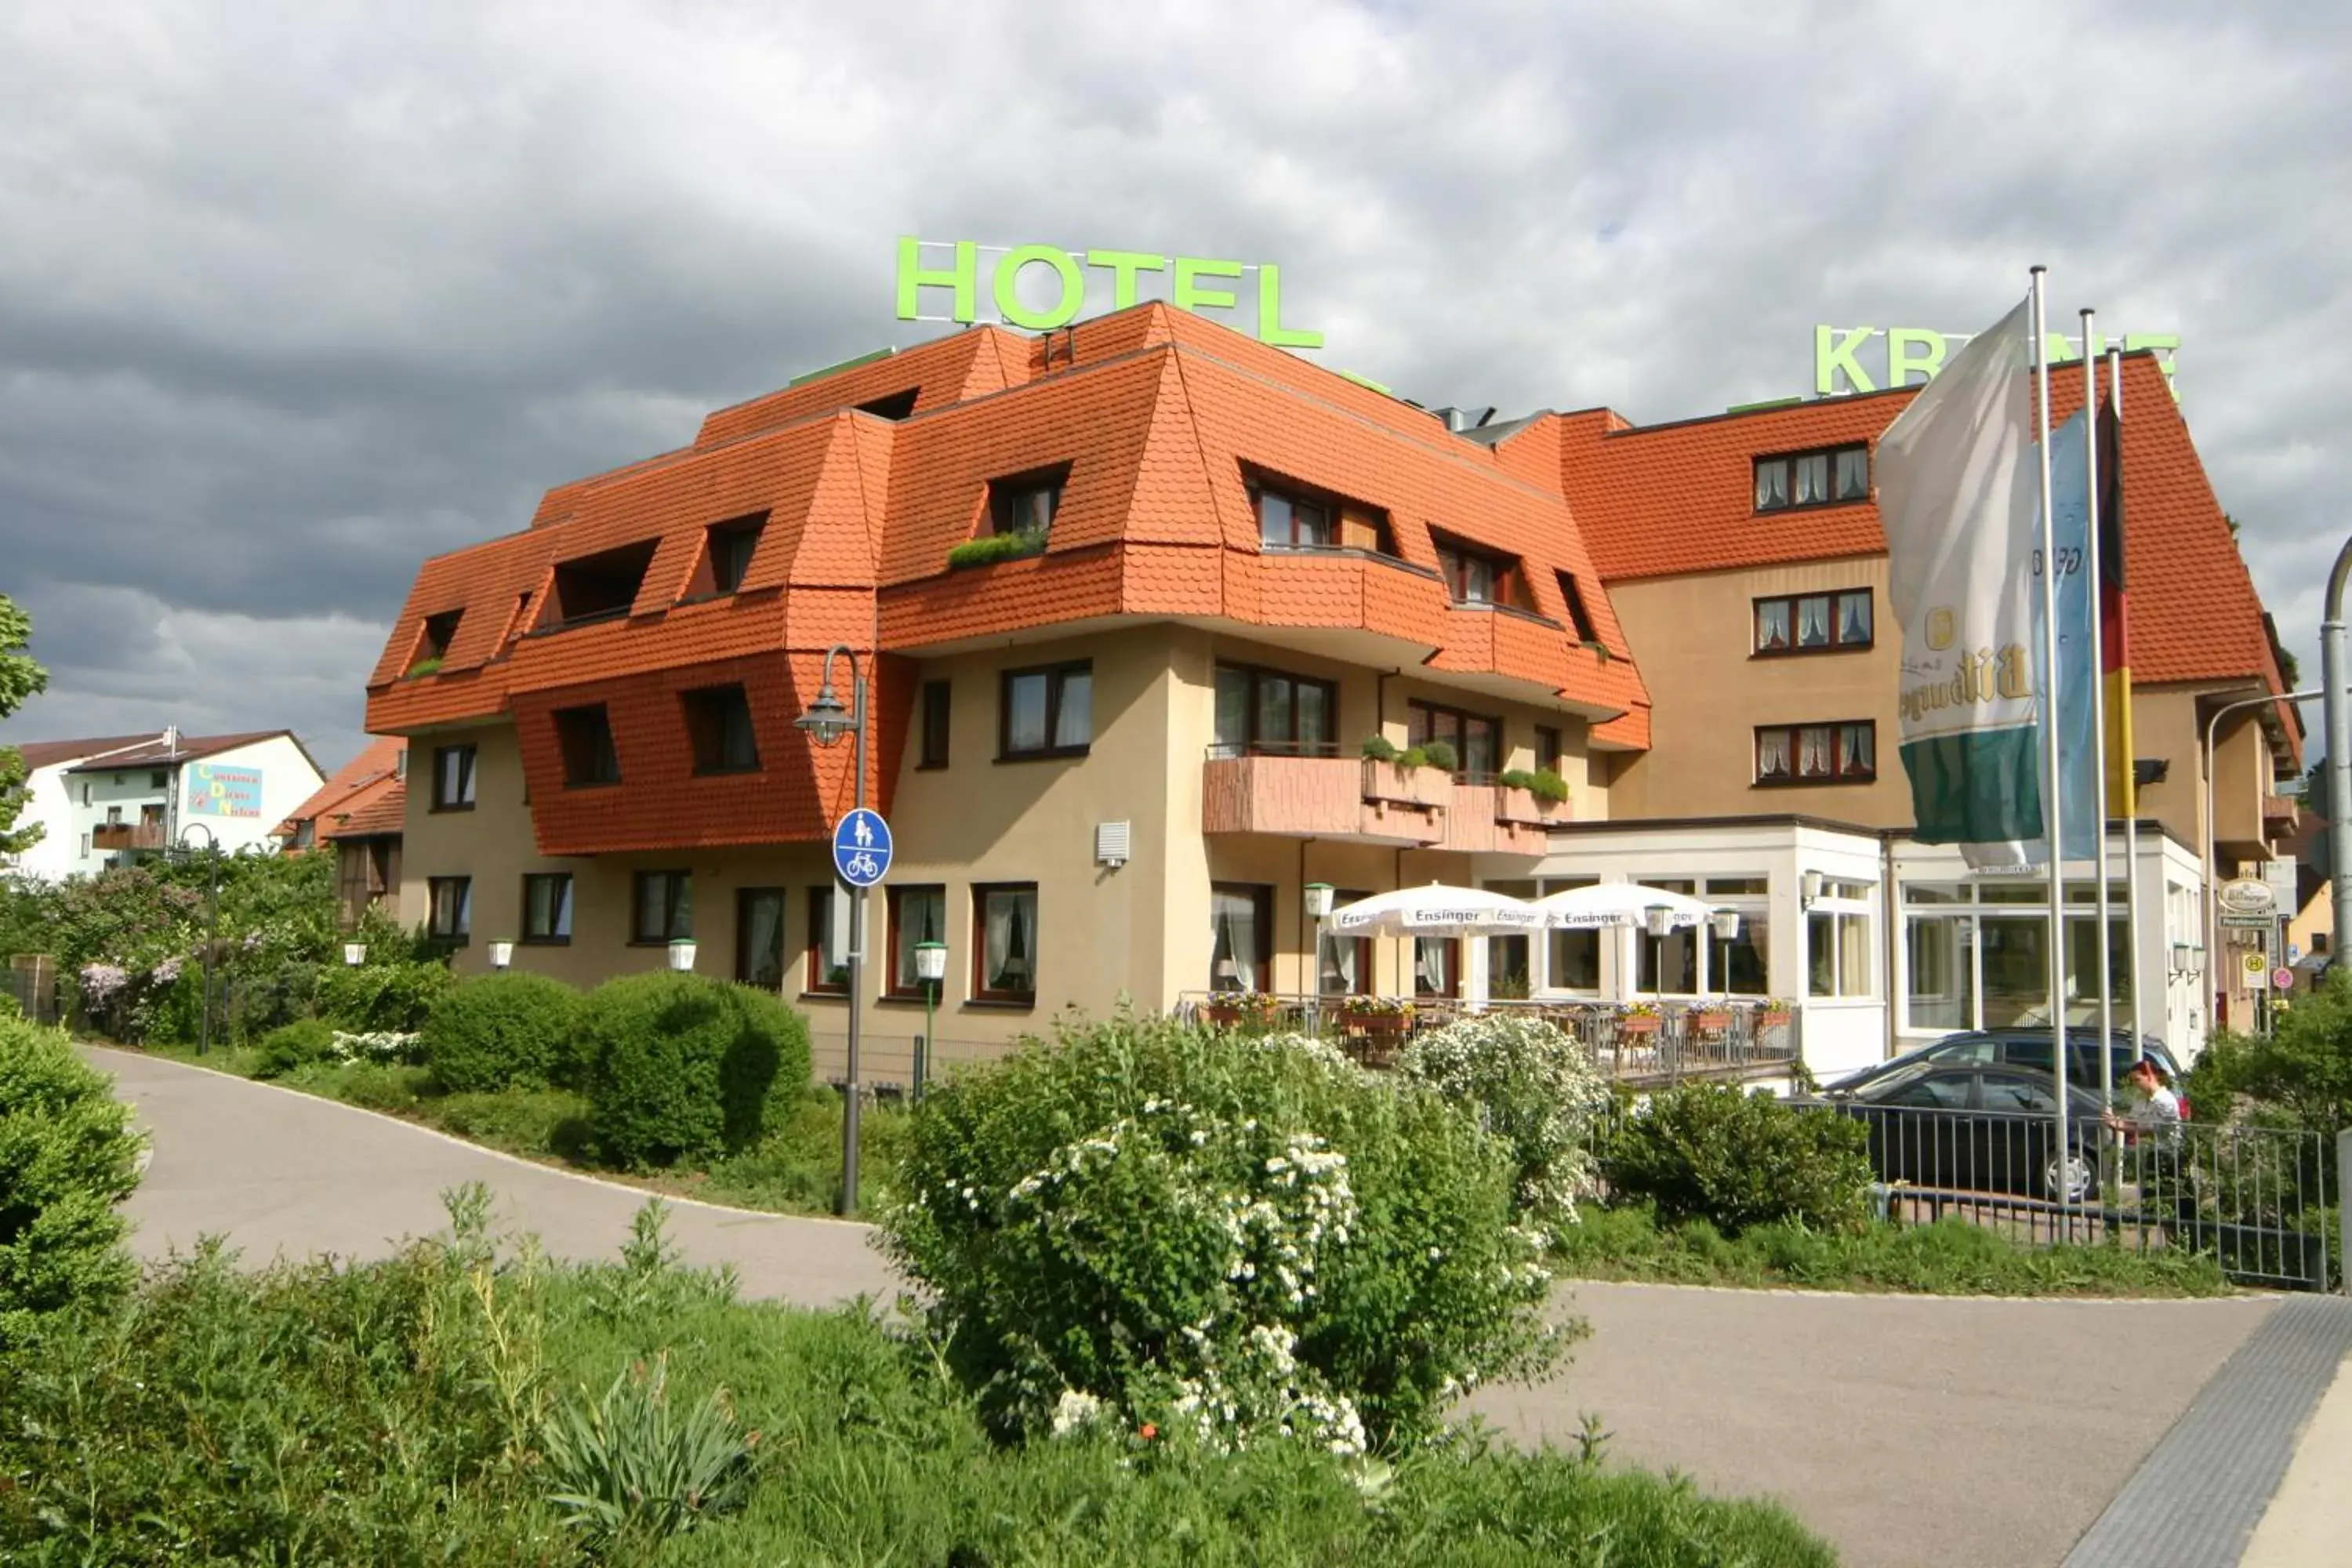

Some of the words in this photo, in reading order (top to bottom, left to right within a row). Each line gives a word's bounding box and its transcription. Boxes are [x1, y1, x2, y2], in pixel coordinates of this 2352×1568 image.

[896, 237, 1323, 347] HOTEL
[1815, 325, 2180, 402] KRE
[1416, 909, 1480, 923] Ensinger
[1564, 911, 1622, 924] Ensinger
